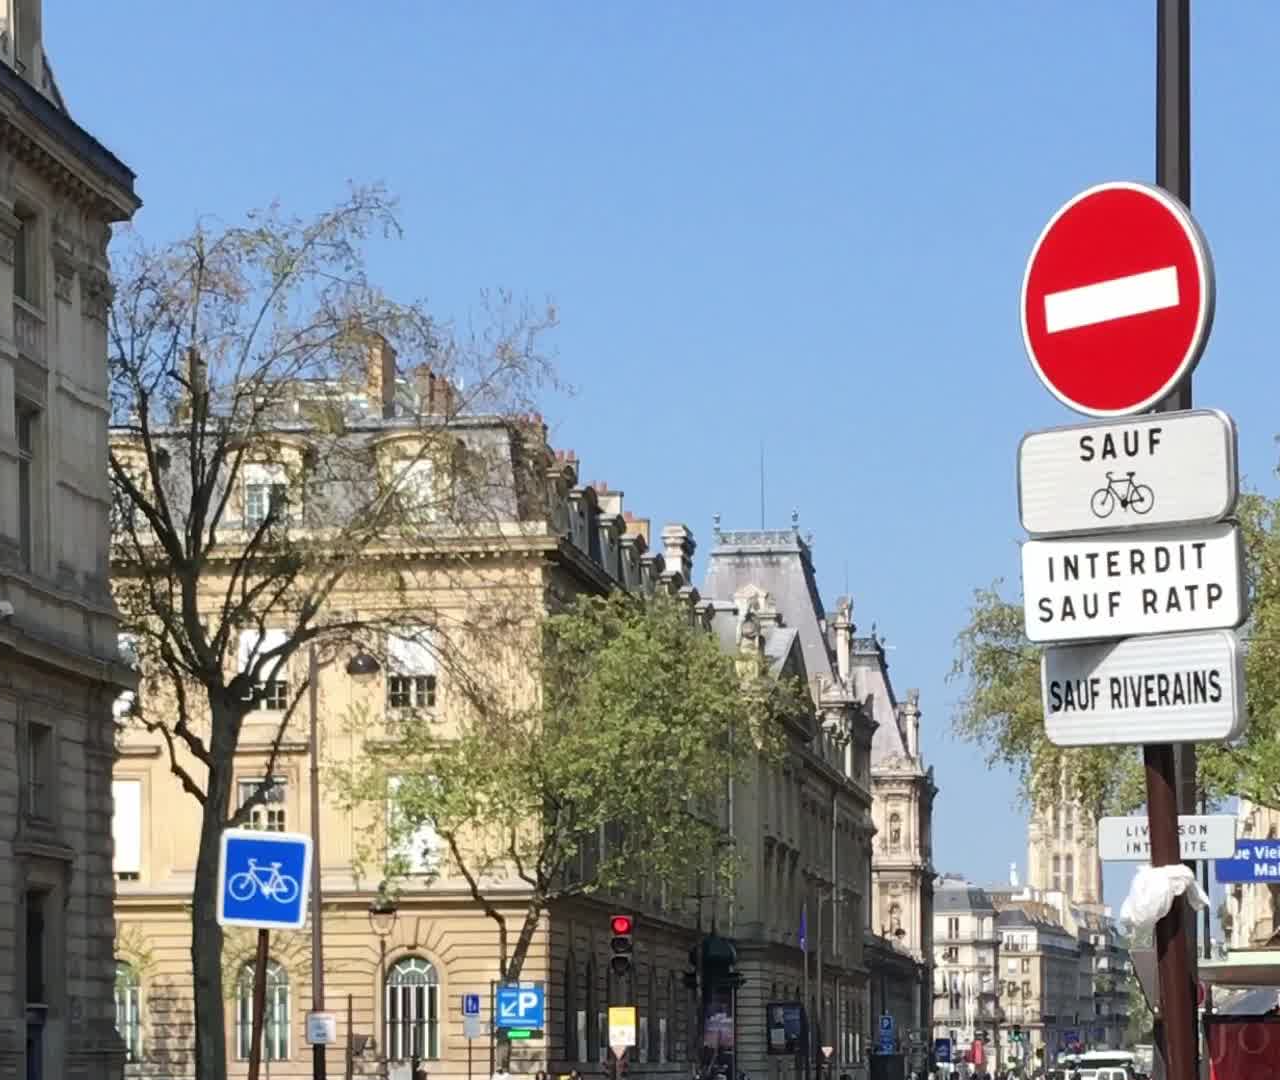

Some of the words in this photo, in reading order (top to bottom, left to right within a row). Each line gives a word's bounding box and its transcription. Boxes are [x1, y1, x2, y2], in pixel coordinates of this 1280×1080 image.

[1079, 427, 1163, 462] SAUF
[1047, 542, 1207, 583] INTERDIT
[1038, 591, 1122, 624] SAUF
[1142, 582, 1224, 615] RATP
[1050, 677, 1101, 713] SAUF
[1109, 669, 1222, 710] RIVERAINS
[1126, 824, 1208, 837] LIVSON
[1126, 841, 1208, 854] INTITE
[519, 992, 538, 1017] P
